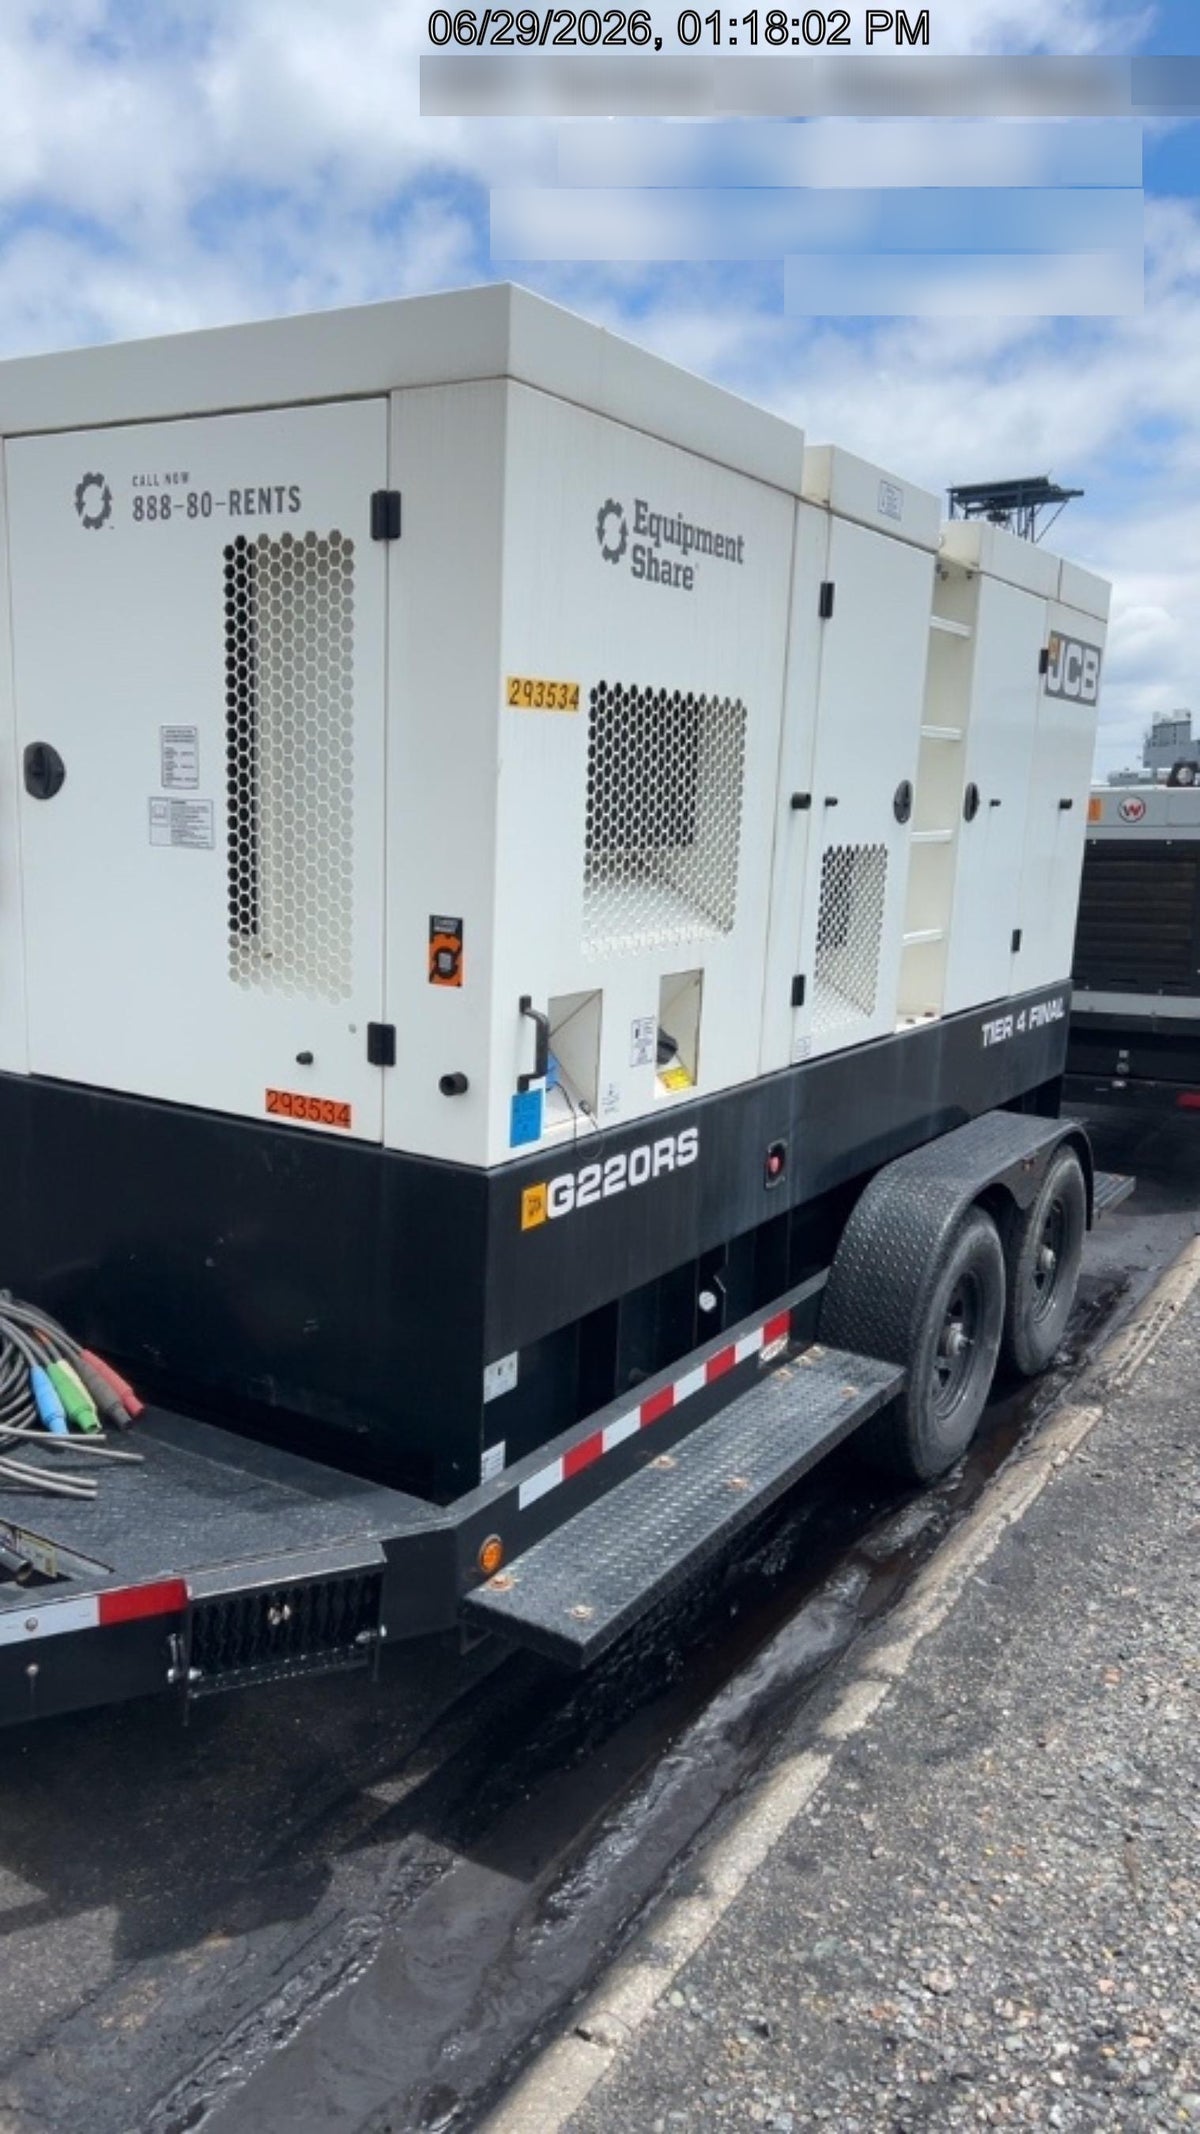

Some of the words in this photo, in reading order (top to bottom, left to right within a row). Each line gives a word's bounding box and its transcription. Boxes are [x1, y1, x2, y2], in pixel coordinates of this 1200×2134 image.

[132, 474, 160, 487] CALL
[165, 472, 189, 485] NOW
[132, 485, 301, 521] 888-80-RENTS
[633, 498, 745, 565] Equipment
[631, 543, 694, 591] Share
[1047, 640, 1099, 699] JCB
[509, 680, 579, 709] 293534
[981, 1014, 1013, 1047] TIER
[1016, 1010, 1025, 1032] 4
[1029, 997, 1064, 1029] FINAL
[266, 1090, 351, 1126] 293534
[547, 1127, 698, 1219] G220RS
